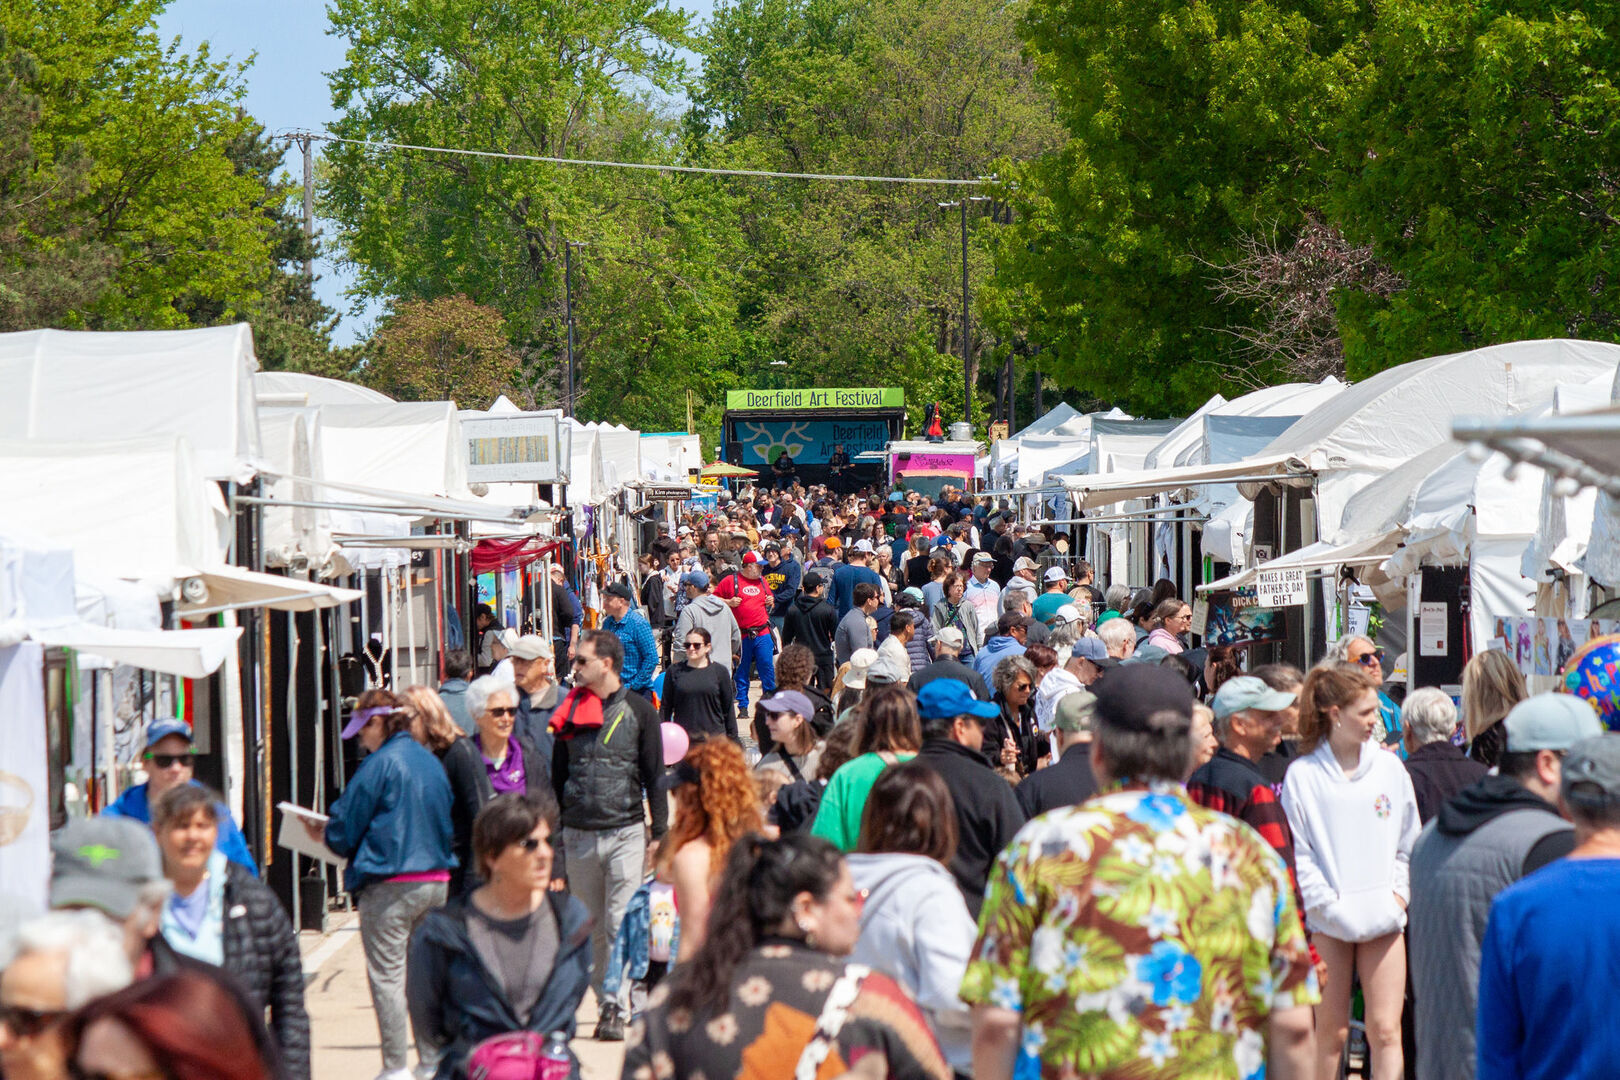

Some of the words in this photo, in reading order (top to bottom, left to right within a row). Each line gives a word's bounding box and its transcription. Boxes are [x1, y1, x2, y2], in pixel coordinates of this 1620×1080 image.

[747, 391, 802, 407] Deerfield
[809, 391, 829, 407] Art
[835, 390, 882, 406] Festival
[833, 424, 883, 440] Deerfield
[1259, 573, 1278, 583] MAKES
[1280, 573, 1284, 581] A
[1285, 571, 1302, 581] GREAT
[1259, 584, 1290, 594] FATHER'S
[1292, 582, 1304, 592] DAY
[1232, 596, 1252, 607] DICK
[1272, 594, 1293, 605] GIFT
